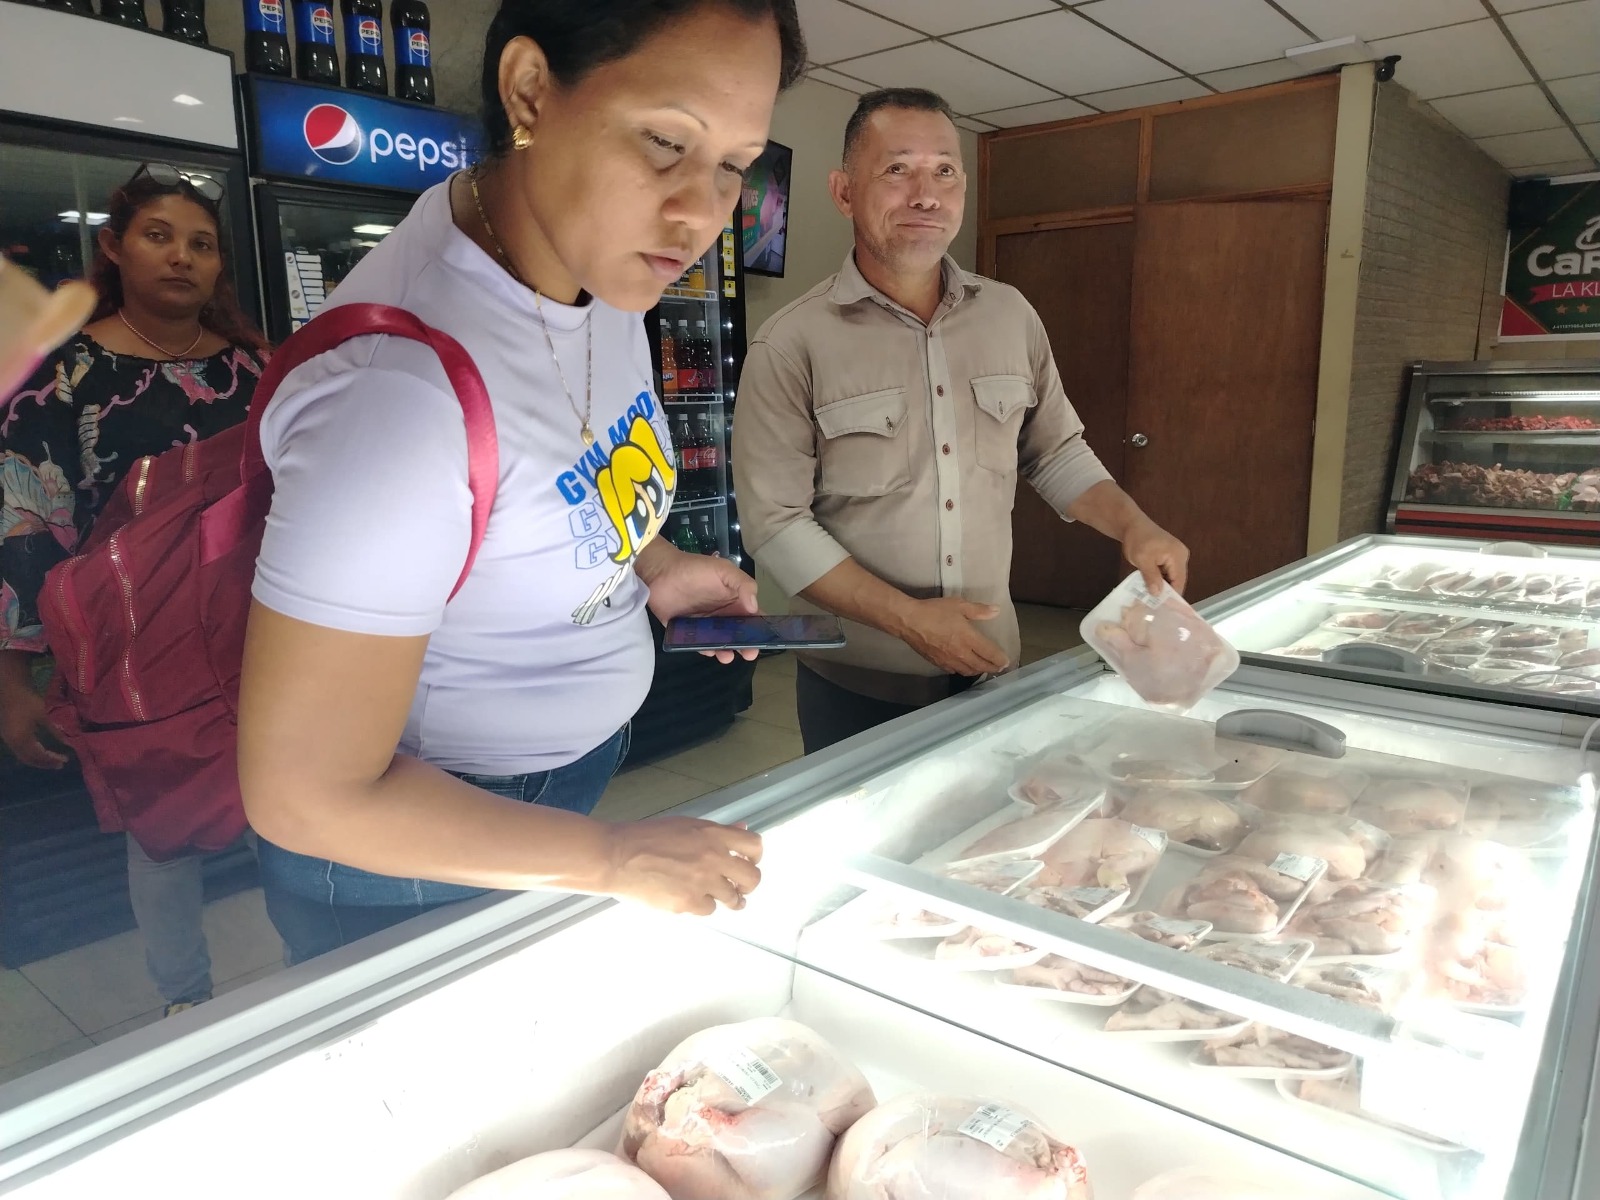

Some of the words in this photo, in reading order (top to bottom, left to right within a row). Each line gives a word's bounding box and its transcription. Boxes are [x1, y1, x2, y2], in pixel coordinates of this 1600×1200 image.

[369, 128, 467, 172] pepsi
[1552, 282, 1576, 298] LA
[555, 441, 609, 506] GYM
[608, 389, 657, 447] MOD
